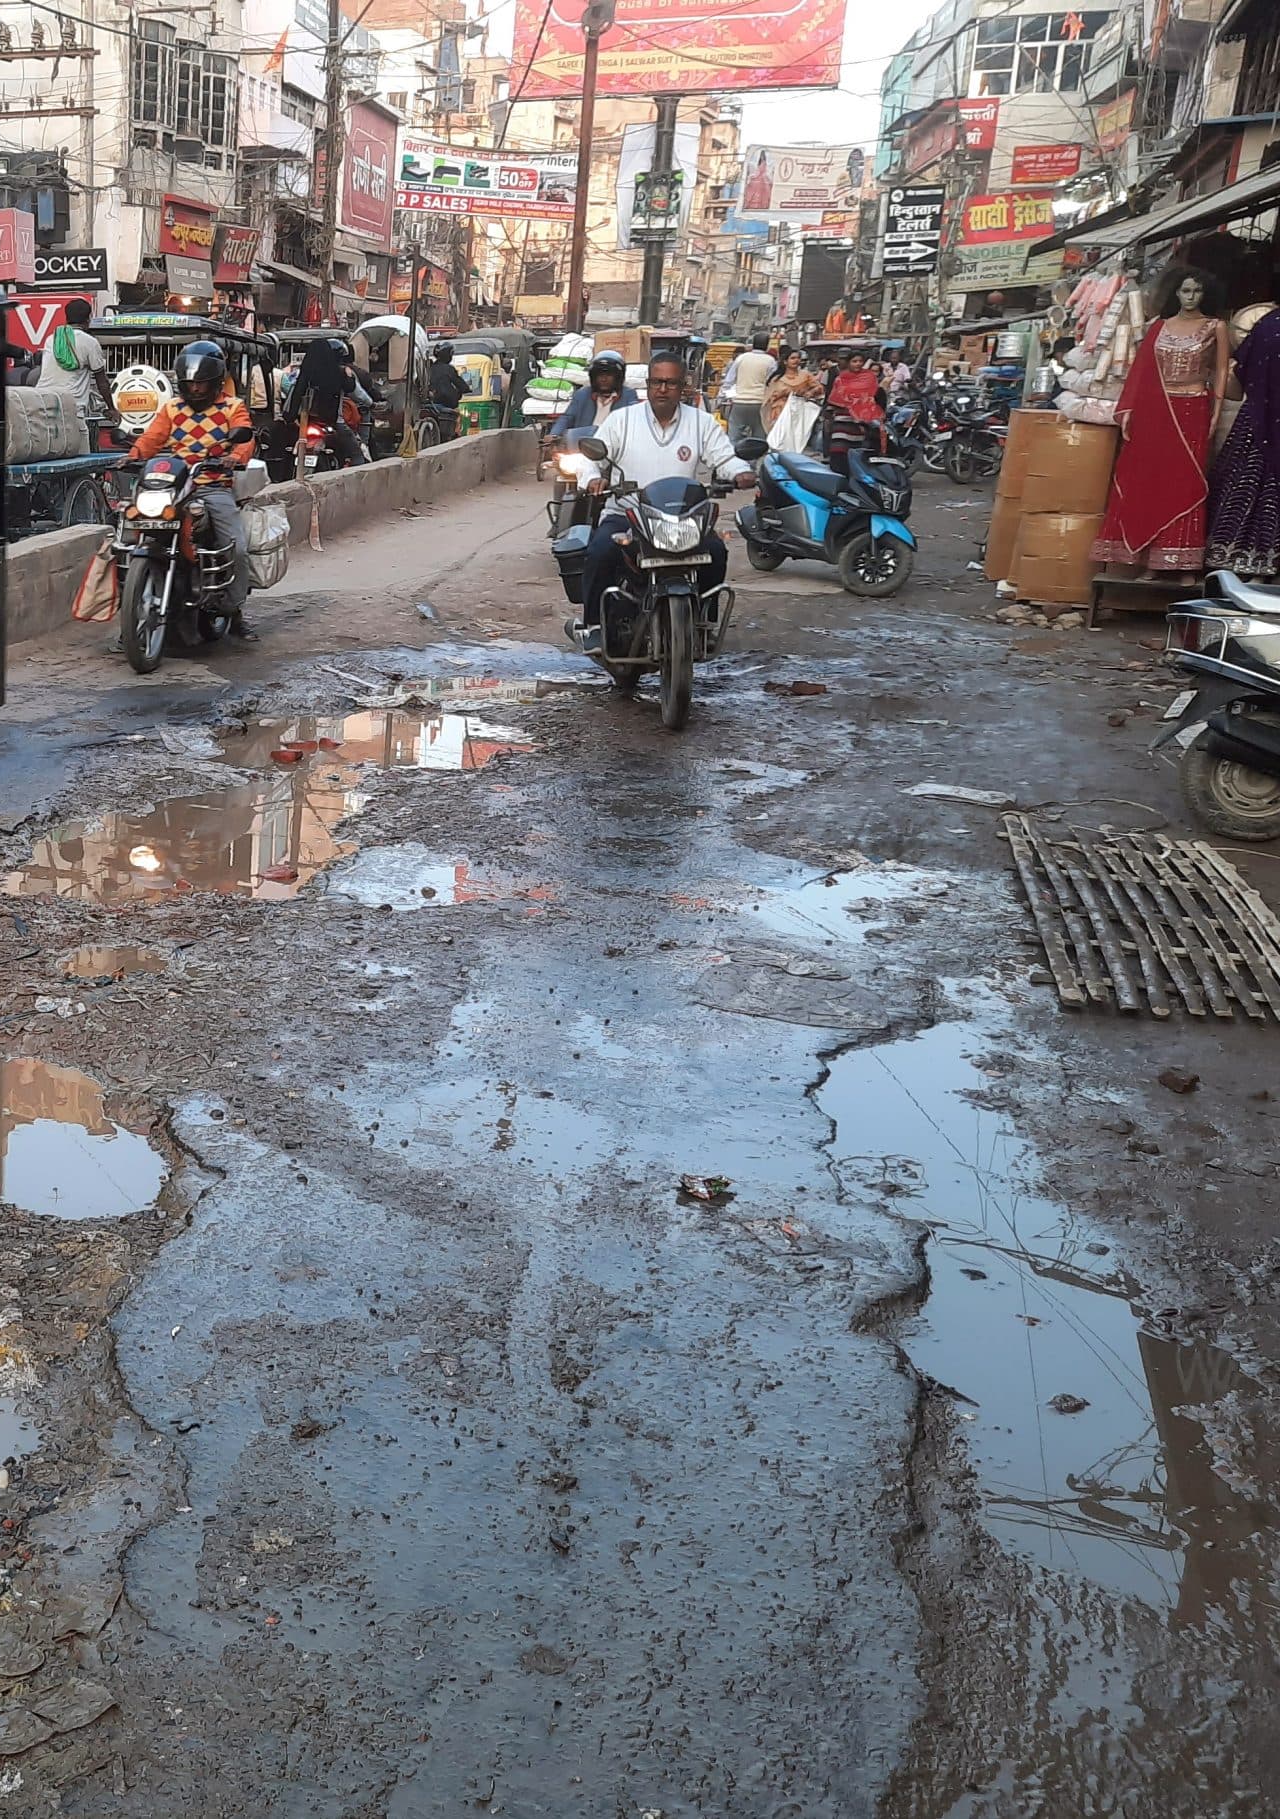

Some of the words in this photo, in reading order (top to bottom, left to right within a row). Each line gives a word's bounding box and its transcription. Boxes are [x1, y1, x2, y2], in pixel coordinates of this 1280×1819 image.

[547, 155, 577, 168] interi
[500, 171, 519, 188] 50
[519, 180, 534, 189] OFF
[397, 194, 407, 206] R
[410, 195, 419, 206] P
[422, 195, 468, 211] SALES
[889, 203, 942, 220] हिन्दुस्तान
[968, 196, 1009, 231] साक्षी
[896, 214, 933, 232] टेलर्स
[21, 231, 31, 253] V
[35, 255, 102, 274] OCKEY
[15, 304, 62, 345] V
[127, 397, 147, 406] yatri
